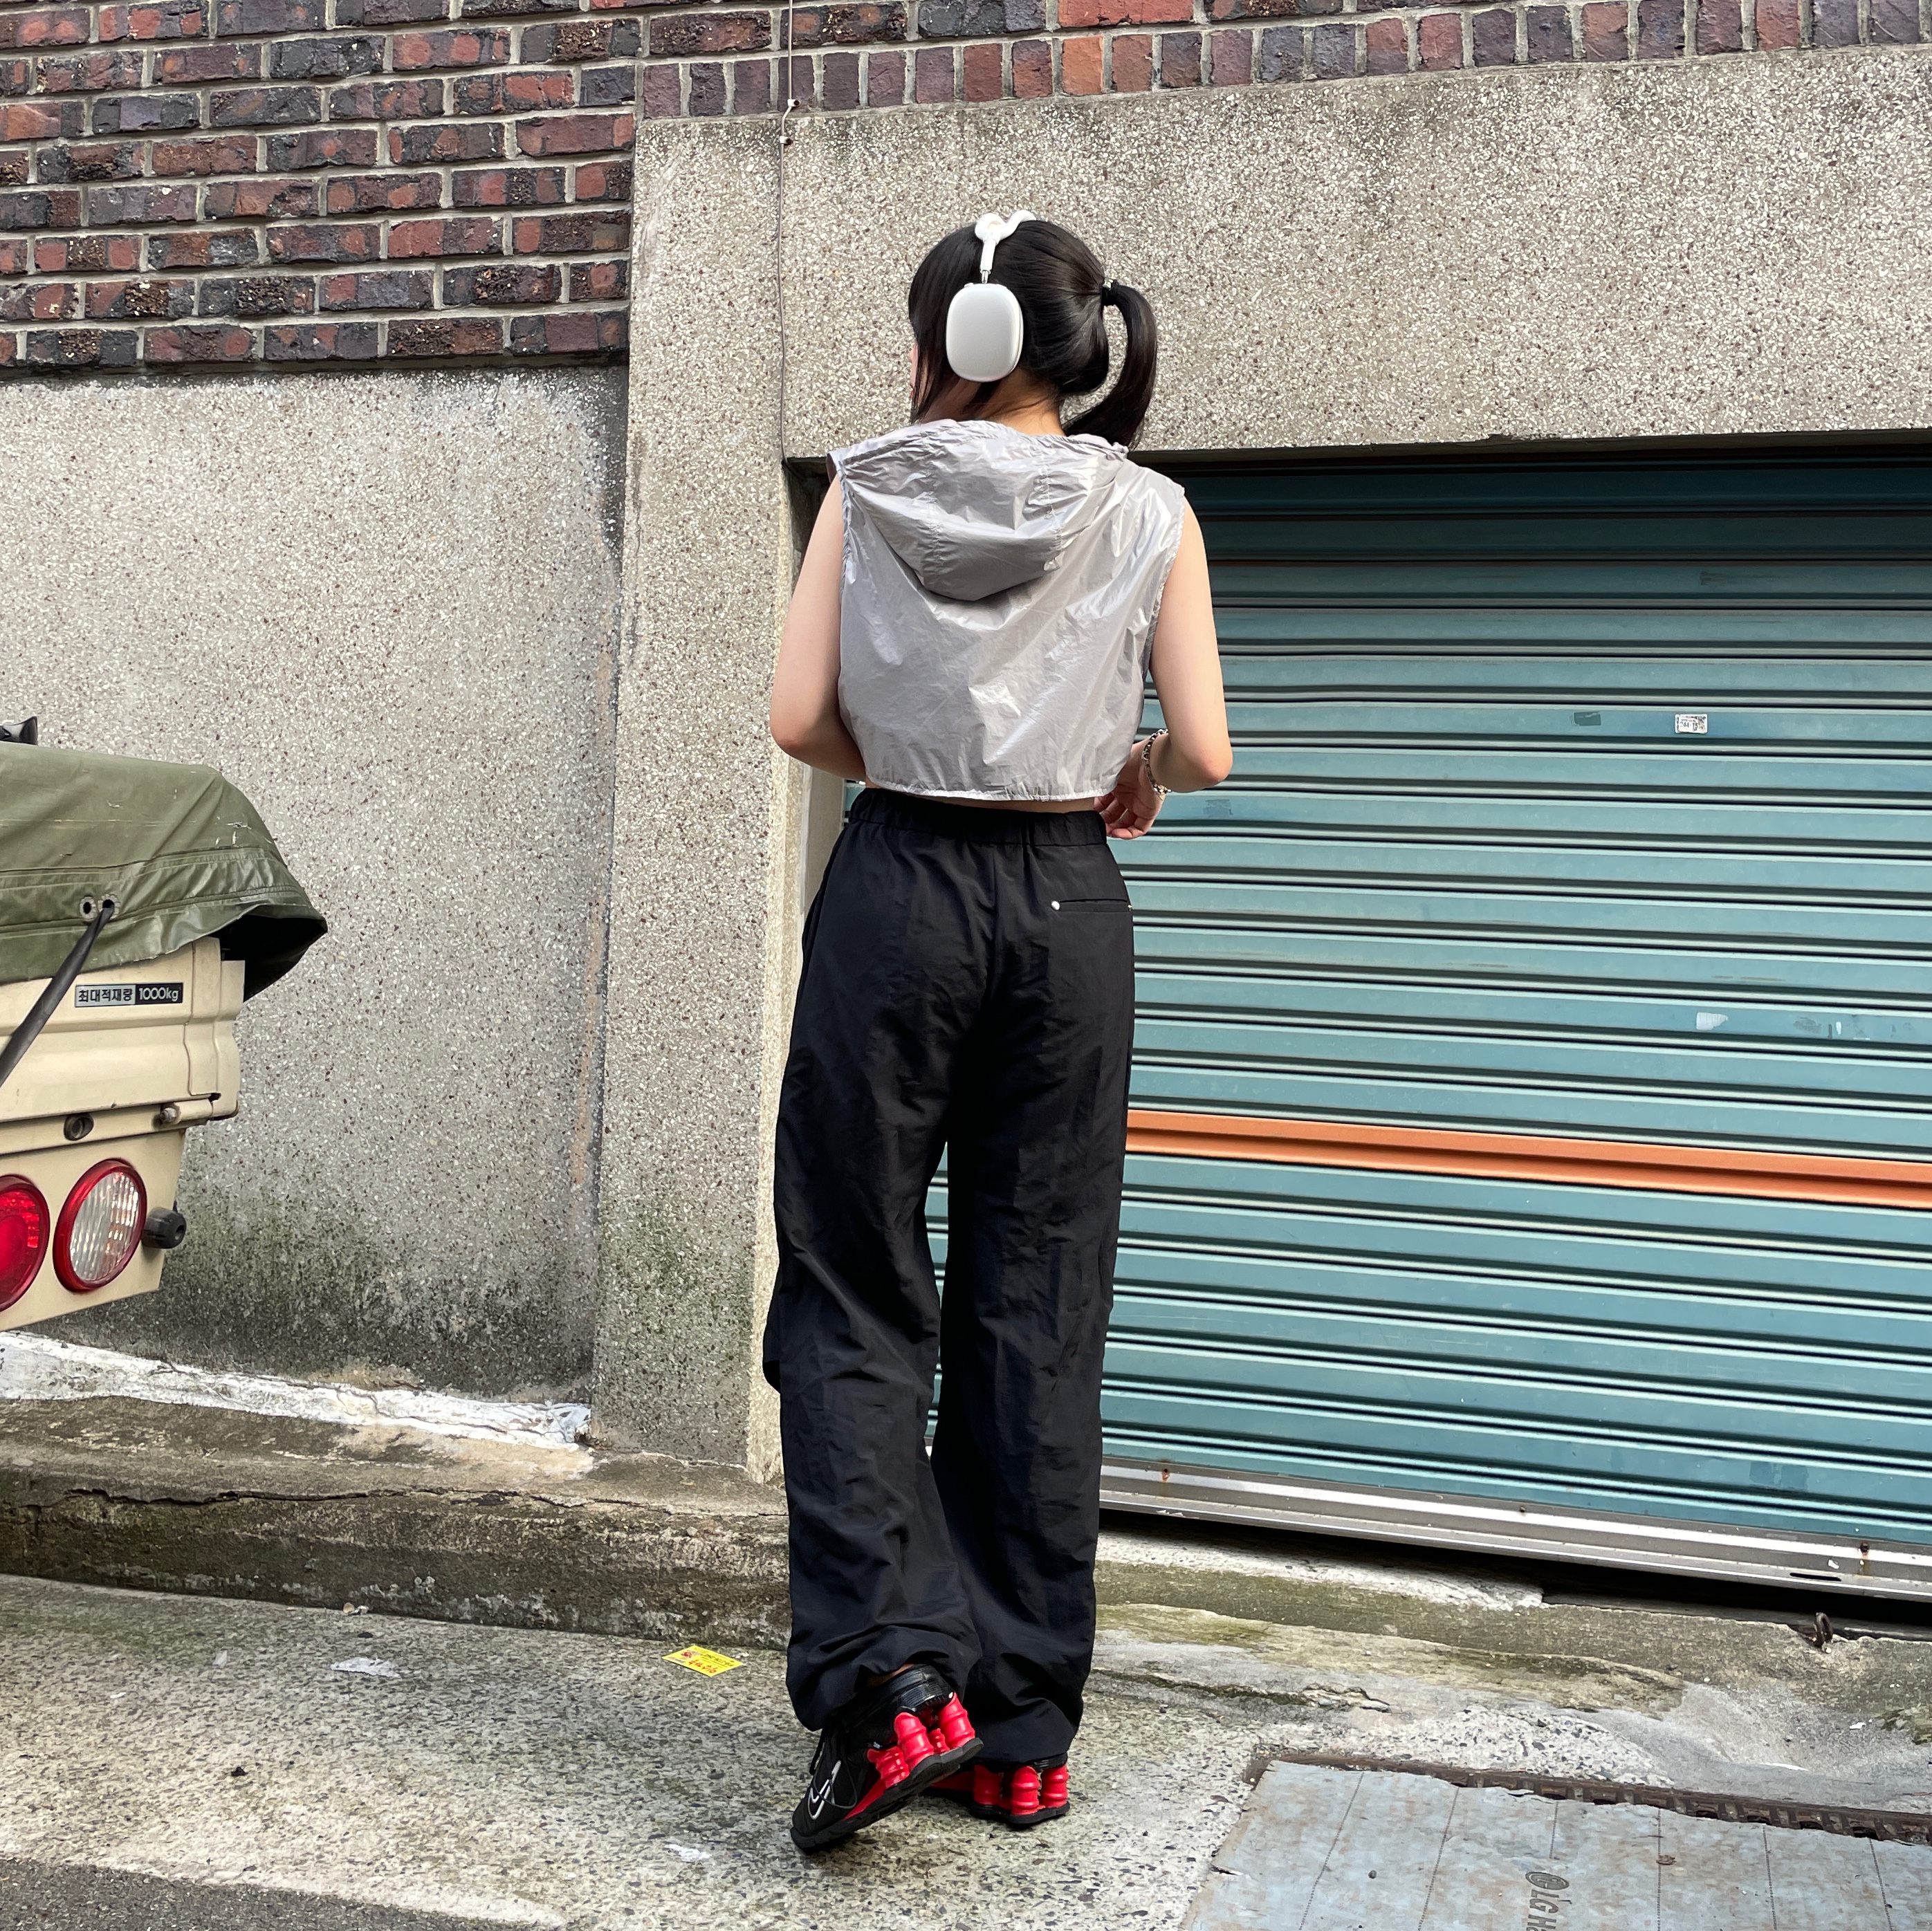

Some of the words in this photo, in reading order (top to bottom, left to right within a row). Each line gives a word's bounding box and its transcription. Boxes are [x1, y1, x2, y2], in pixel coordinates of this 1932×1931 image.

[78, 988, 134, 1002] 최대적재량
[139, 987, 178, 1001] 1000kg
[1529, 1889, 1559, 1913] LG
